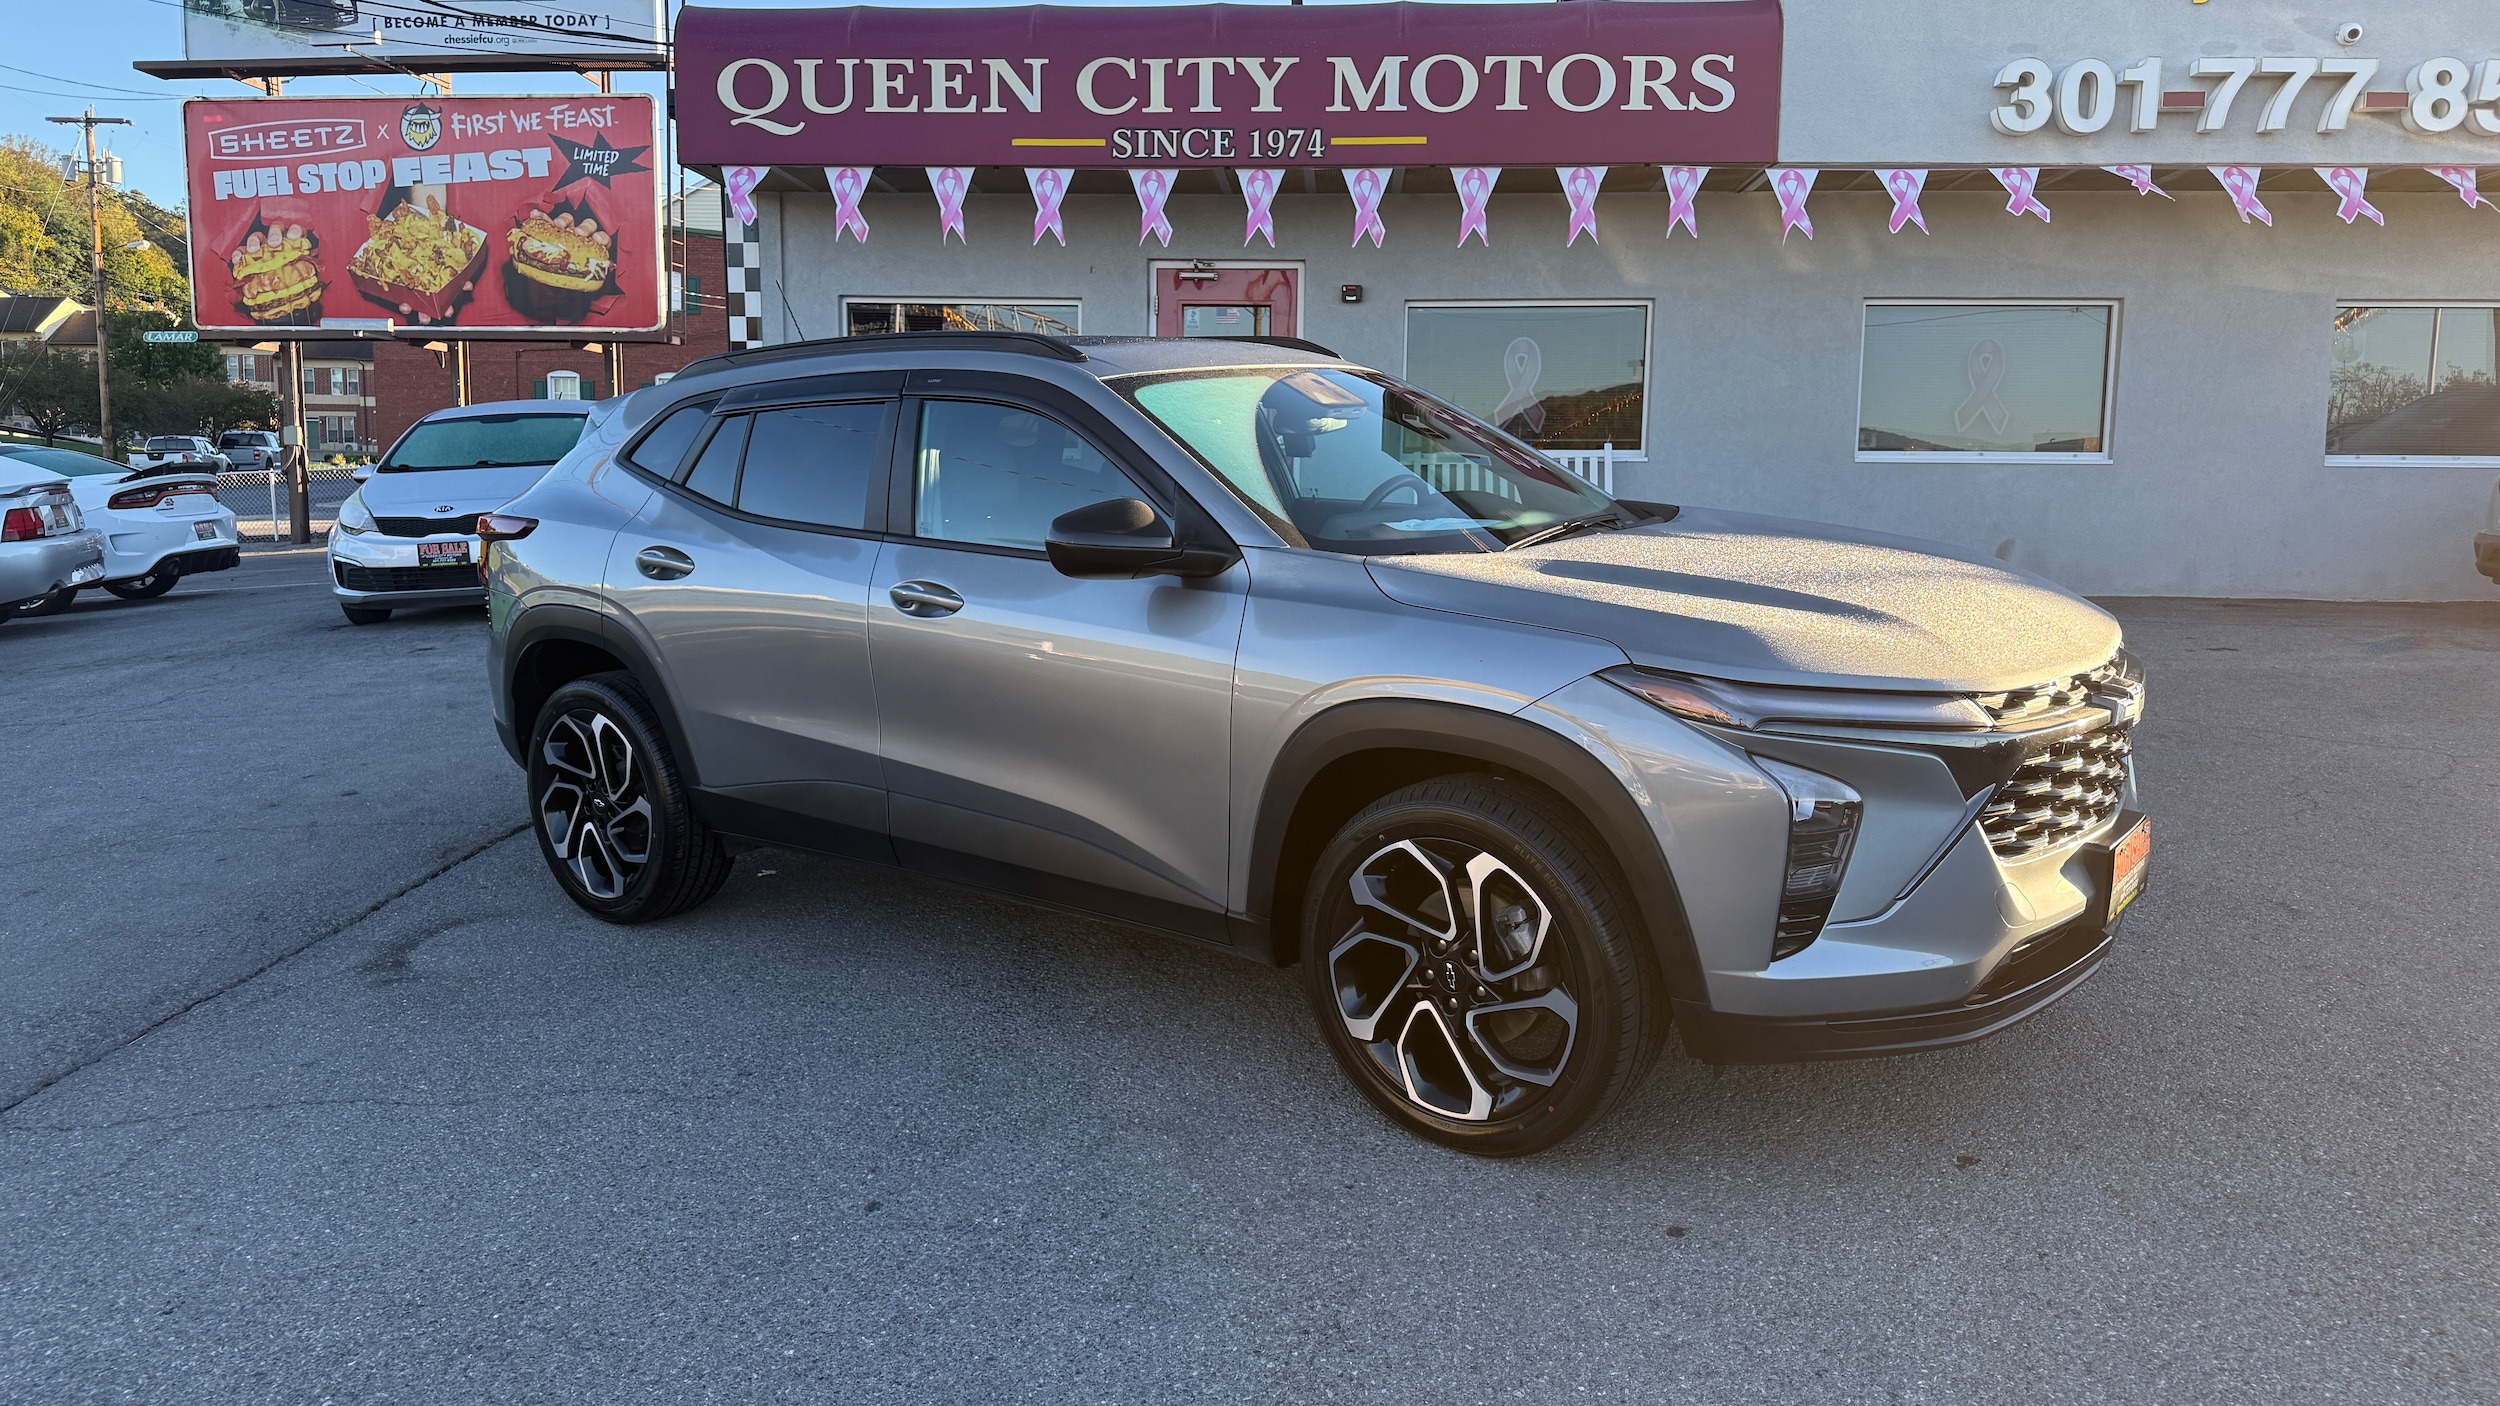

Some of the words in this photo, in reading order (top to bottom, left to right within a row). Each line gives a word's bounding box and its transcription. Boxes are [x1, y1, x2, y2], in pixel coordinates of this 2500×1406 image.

[384, 17, 448, 29] BECOME
[455, 16, 466, 28] A
[545, 15, 599, 27] TODAY
[444, 34, 510, 46] chessiefcu.org
[716, 58, 1050, 136] QUEEN
[1075, 57, 1300, 115] CITY
[1325, 53, 1737, 113] MOTORS
[220, 125, 355, 154] SHEETZ
[451, 111, 507, 140] FIRST
[510, 109, 542, 133] WE
[545, 104, 616, 131] FEAST
[1111, 128, 1236, 160] SINCE
[1248, 128, 1326, 159] 1974
[573, 147, 620, 165] LIMITED
[213, 166, 294, 201] FUEL
[297, 159, 387, 194] STOP
[392, 147, 552, 188] FEAST
[582, 161, 610, 178] TIME
[148, 332, 193, 341] LAMAR
[419, 544, 440, 556] FOR
[442, 542, 467, 554] SALE
[1513, 843, 1543, 872] ELITE
[1543, 873, 1568, 902] EDGE
